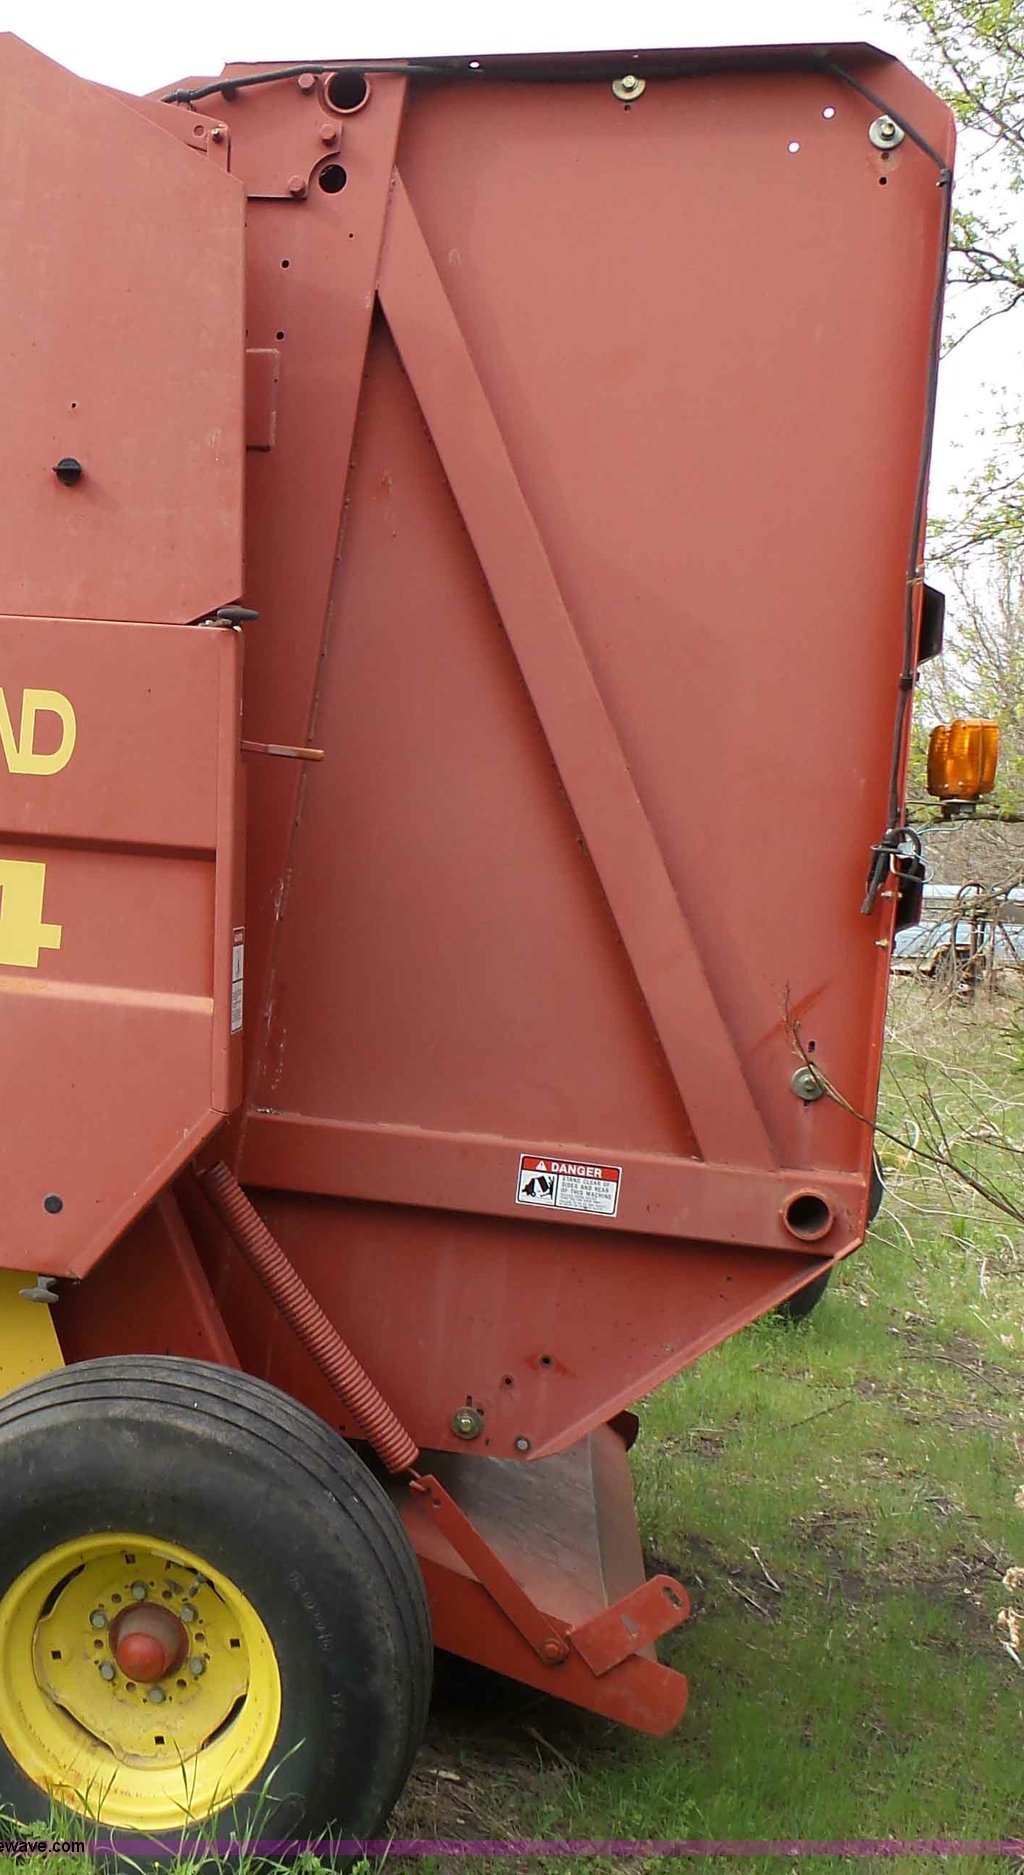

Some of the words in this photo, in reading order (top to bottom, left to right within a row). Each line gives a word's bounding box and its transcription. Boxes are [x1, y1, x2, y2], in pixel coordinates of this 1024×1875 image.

[551, 1162, 603, 1178] DANGER
[571, 1188, 584, 1196] THIS
[586, 1190, 612, 1200] MACHINE
